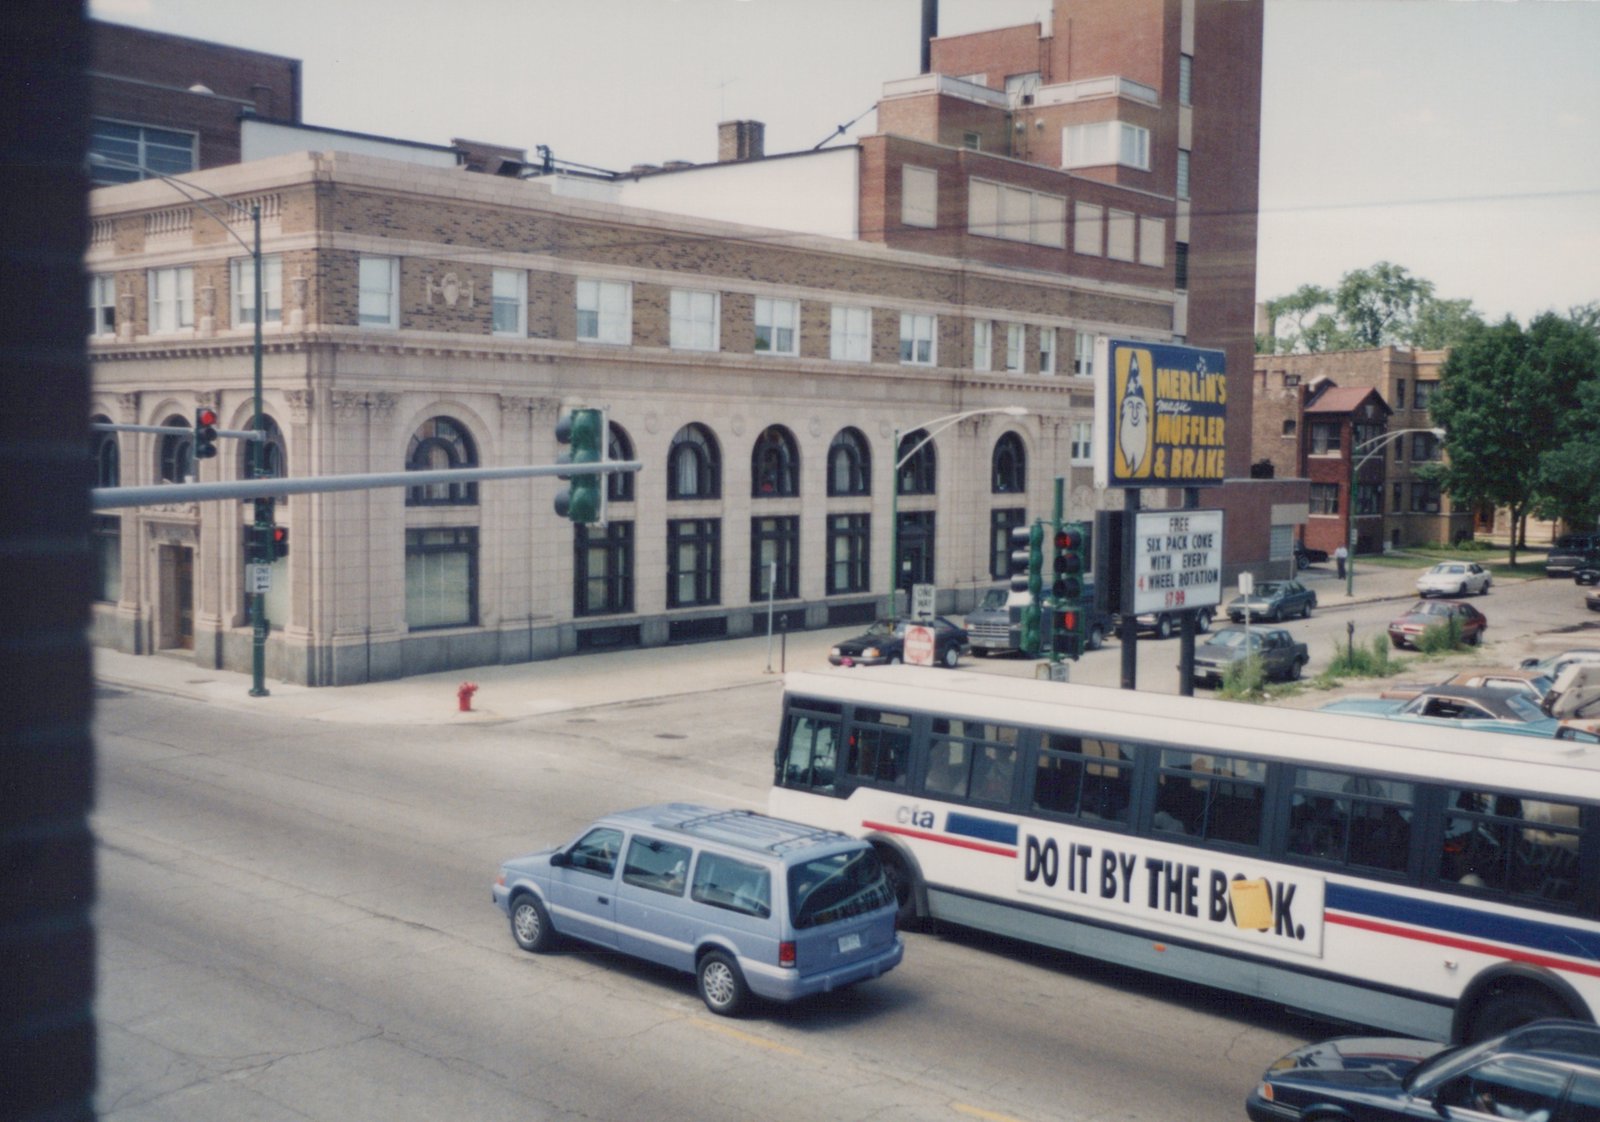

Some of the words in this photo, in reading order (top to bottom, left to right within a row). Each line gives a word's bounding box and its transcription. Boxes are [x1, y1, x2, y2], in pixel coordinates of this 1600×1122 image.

[1155, 414, 1225, 445] MUFFLER
[1154, 447, 1167, 477] &
[1170, 448, 1225, 478] BRAKE
[1169, 518, 1189, 532] FREE
[1147, 537, 1161, 552] SIX
[1166, 535, 1188, 551] PACK
[1192, 534, 1213, 549] COKE
[1151, 556, 1171, 570] WITH
[1182, 552, 1208, 568] EVERY
[1148, 574, 1174, 589] WHEEL
[1178, 569, 1218, 587] ROTATION
[917, 586, 932, 597] ONE
[917, 599, 932, 607] WAY
[896, 804, 935, 829] cta
[1024, 833, 1059, 887] DO
[1068, 842, 1092, 894] IT
[1100, 848, 1137, 903] BY
[1145, 857, 1200, 918] THE
[1208, 869, 1306, 941] BK.
